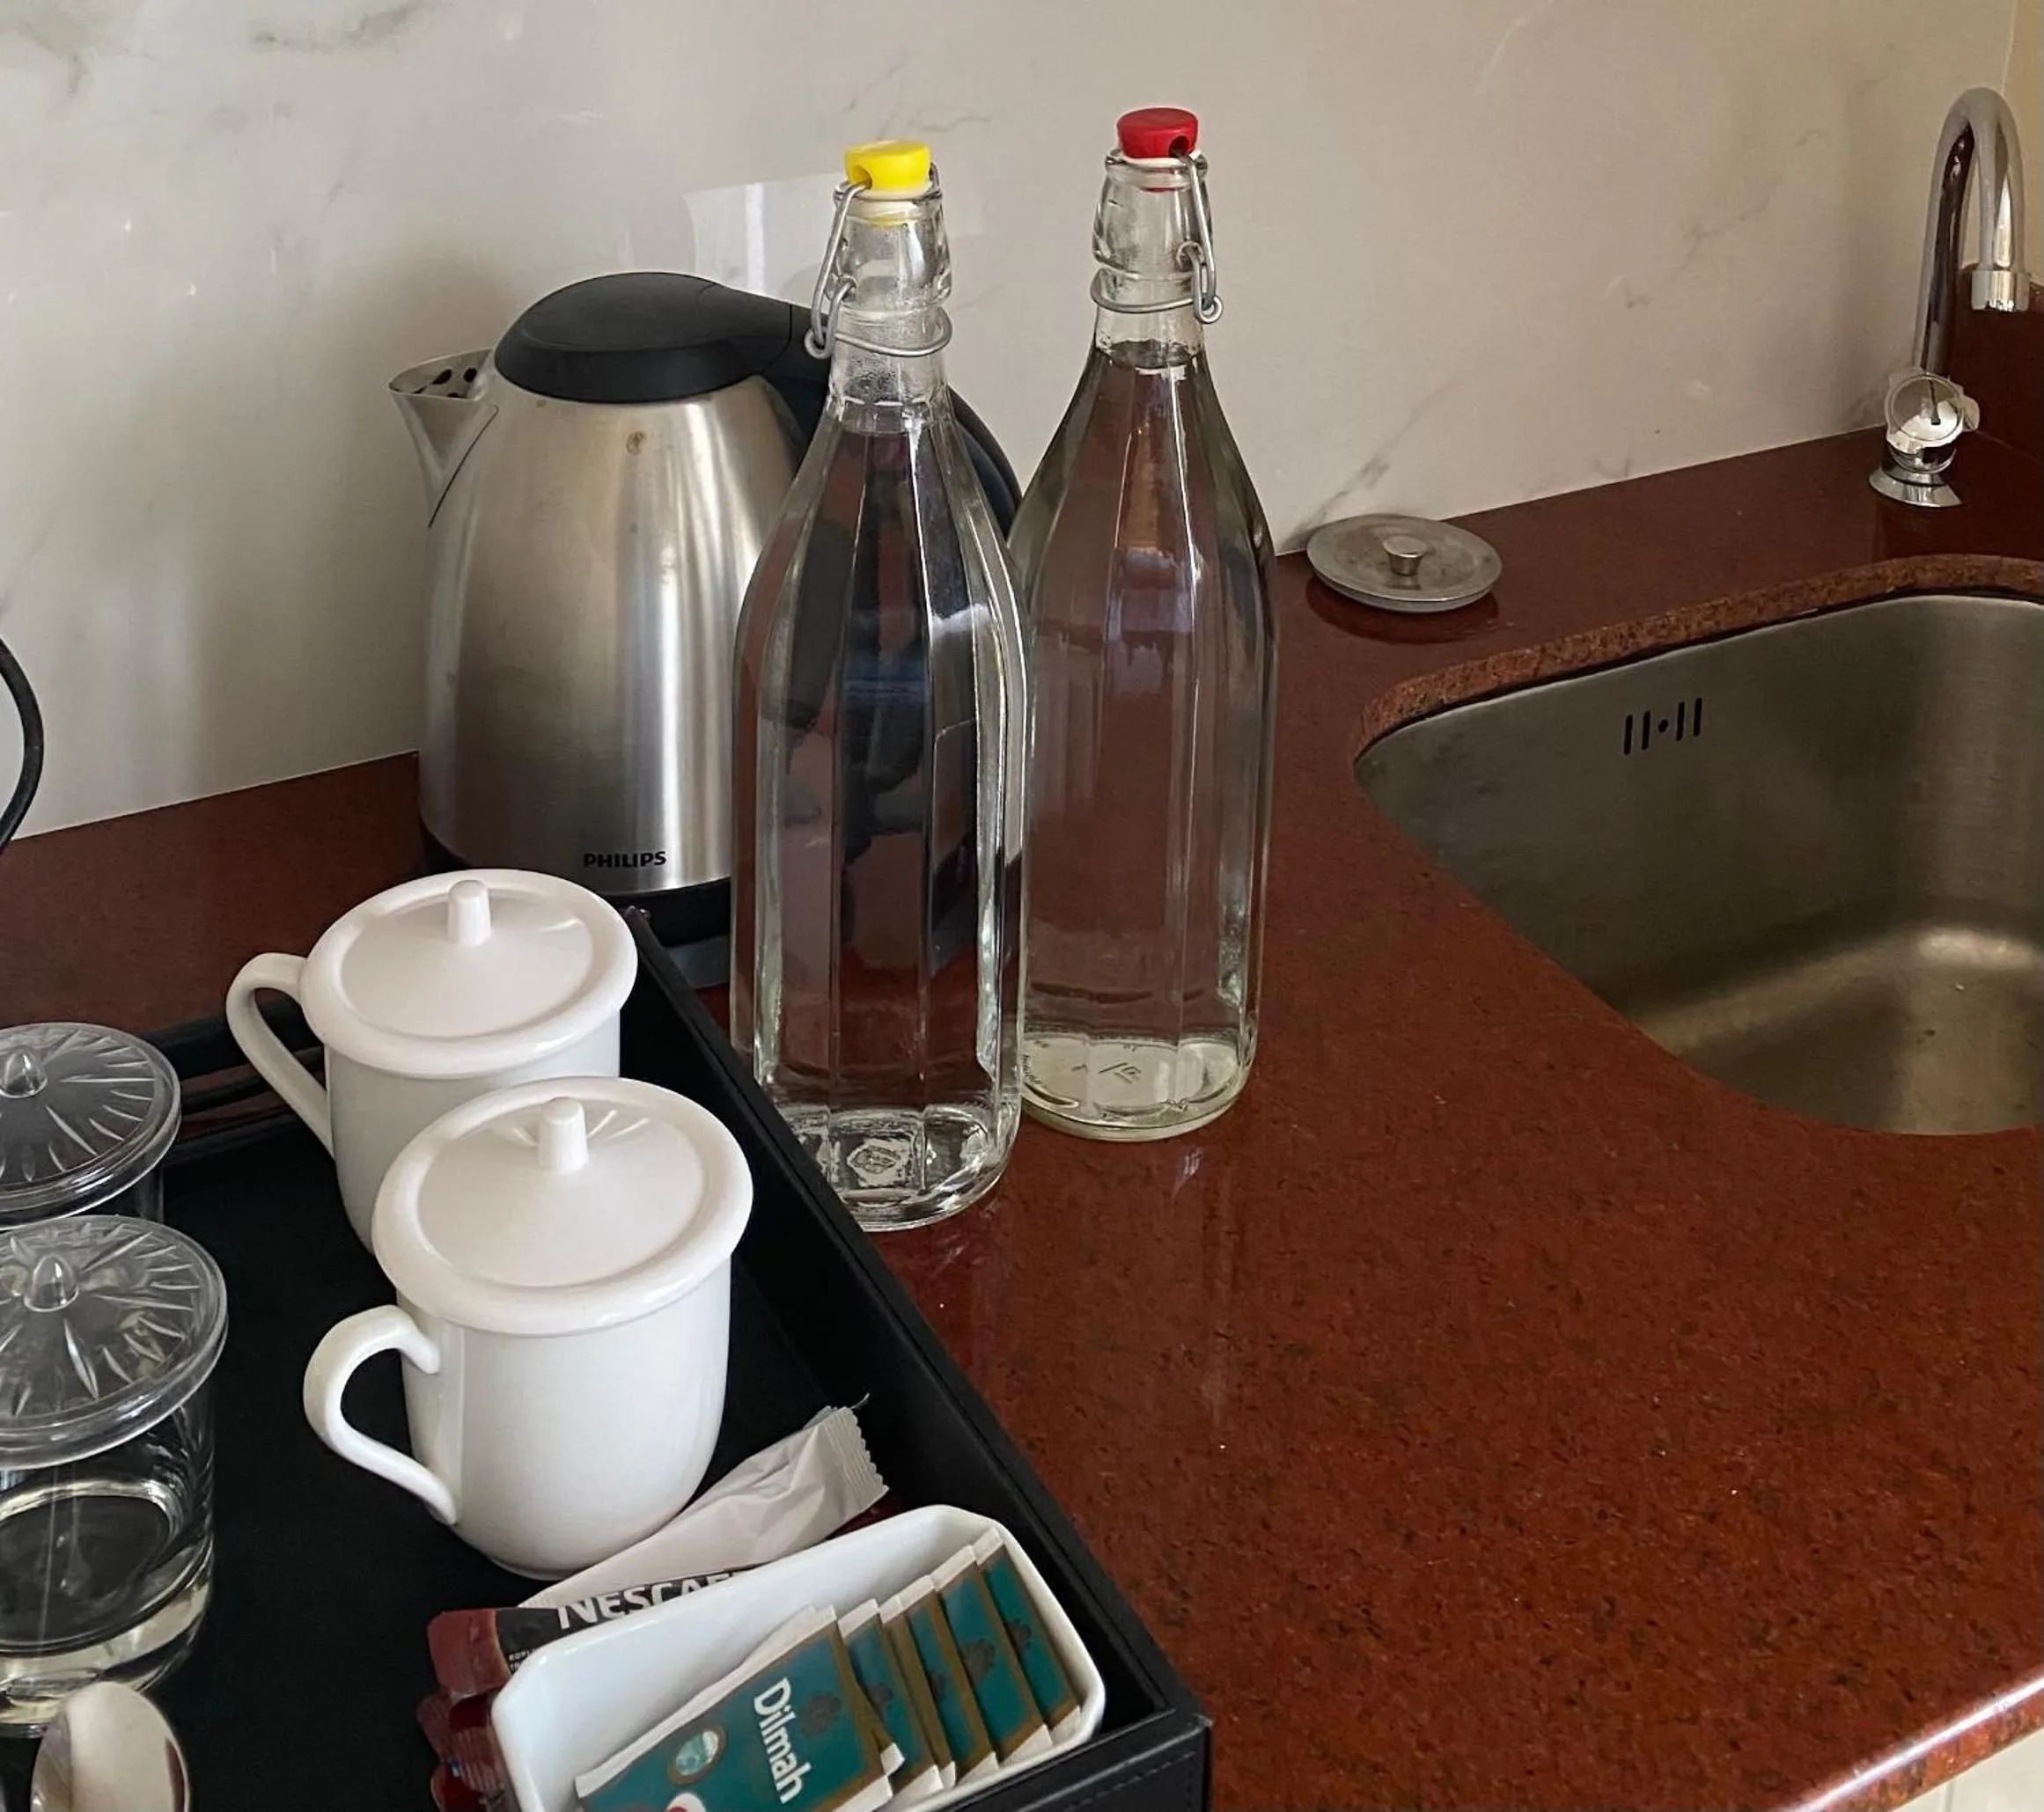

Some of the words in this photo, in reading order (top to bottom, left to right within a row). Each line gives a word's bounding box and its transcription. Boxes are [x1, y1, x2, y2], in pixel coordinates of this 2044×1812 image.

[583, 850, 667, 869] PHILIPS
[556, 1572, 743, 1629] NESCA
[754, 1676, 812, 1805] Dilmah
